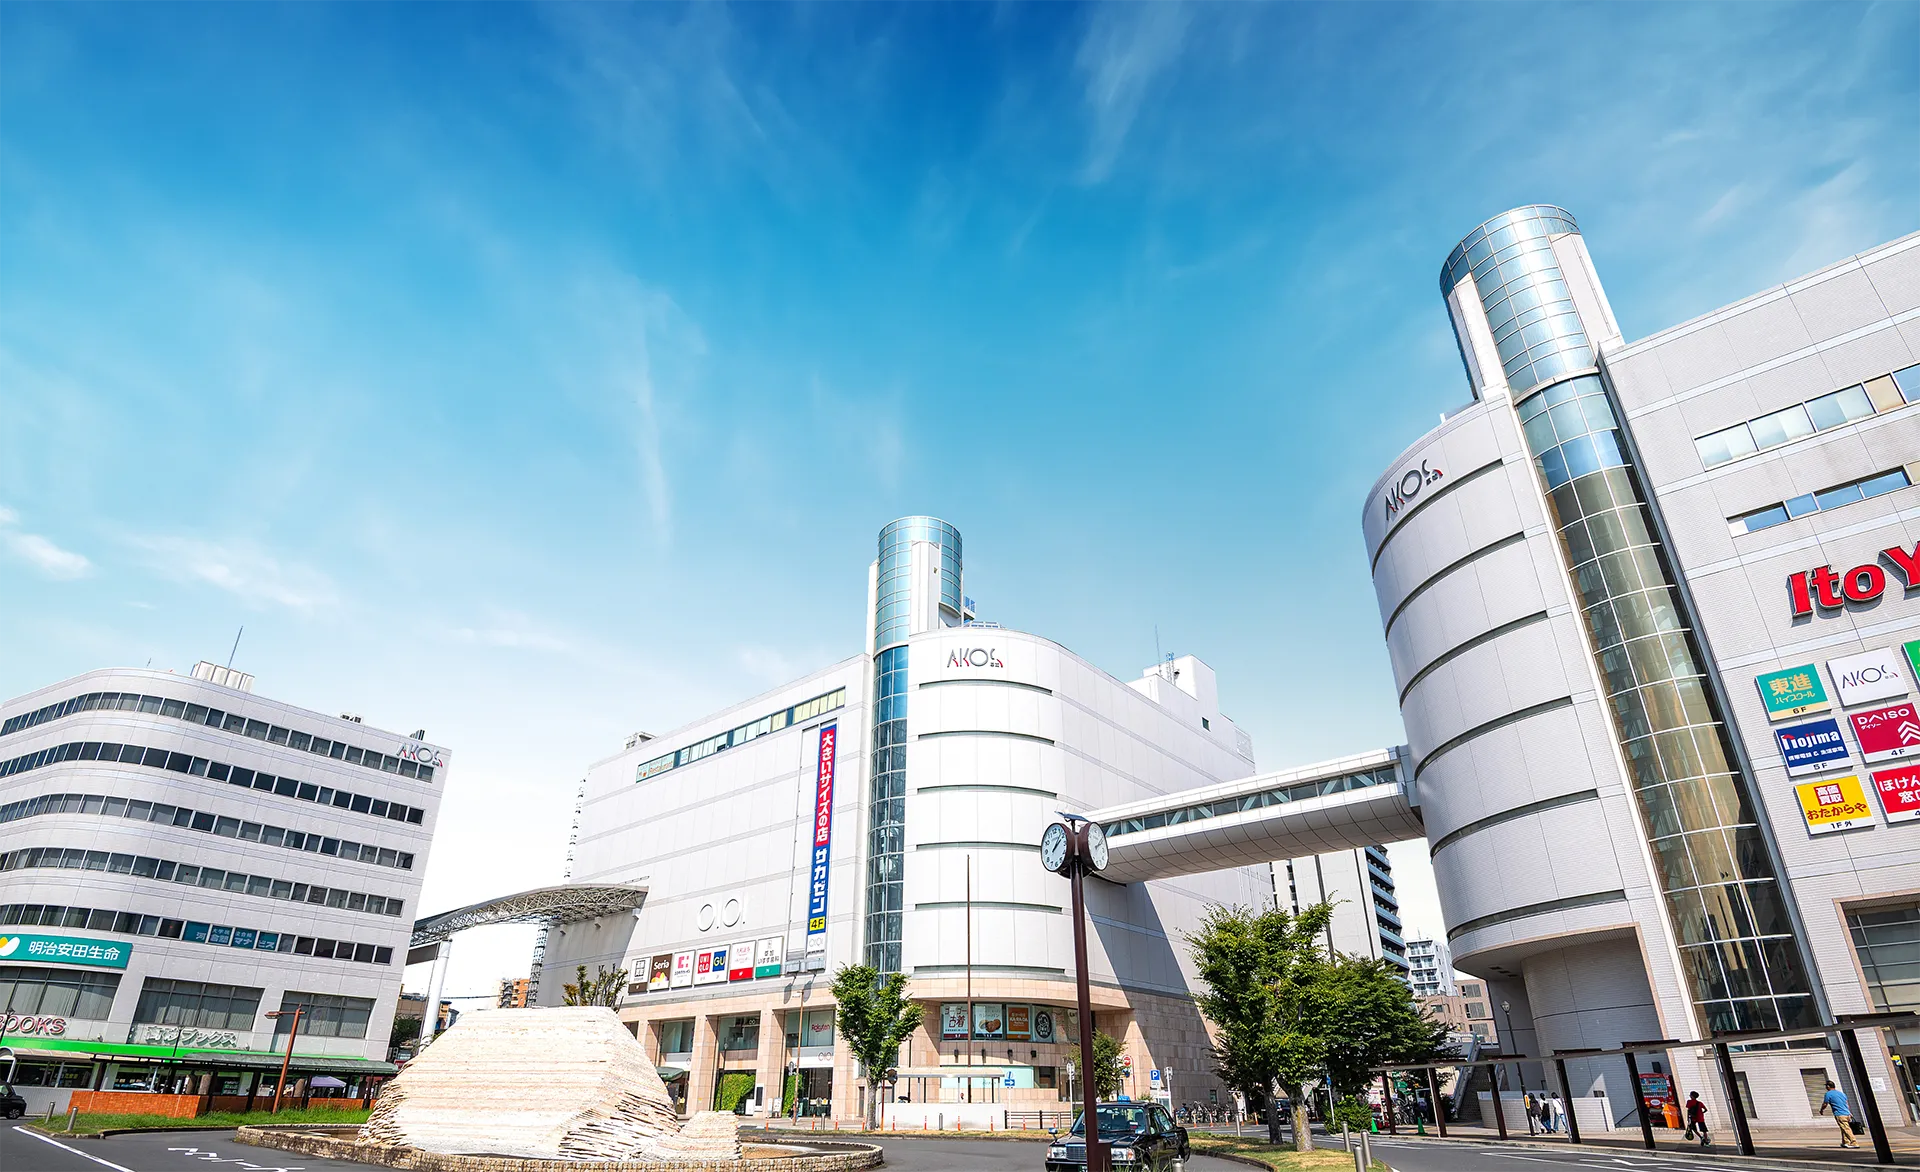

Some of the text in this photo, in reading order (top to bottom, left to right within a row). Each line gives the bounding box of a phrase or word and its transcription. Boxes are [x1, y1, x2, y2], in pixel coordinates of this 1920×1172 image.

[947, 648, 1003, 668] AKOS
[1768, 673, 1813, 696] 東進
[1842, 665, 1898, 689] AKOS
[1776, 691, 1815, 704] ハイスクール
[1857, 708, 1909, 725] DAISO
[1780, 731, 1840, 750] nojima
[816, 733, 834, 843] 大きいサイズの店
[1816, 785, 1839, 796] 高価
[1819, 794, 1843, 805] 買取
[1807, 803, 1867, 820] おたからや
[812, 848, 827, 914] サカゼン
[811, 918, 823, 928] 4F
[28, 941, 121, 960] 明治安田生命
[653, 959, 670, 970] Seria
[714, 956, 726, 967] GU
[0, 1015, 67, 1034] OOKS
[1152, 1071, 1158, 1080] P
